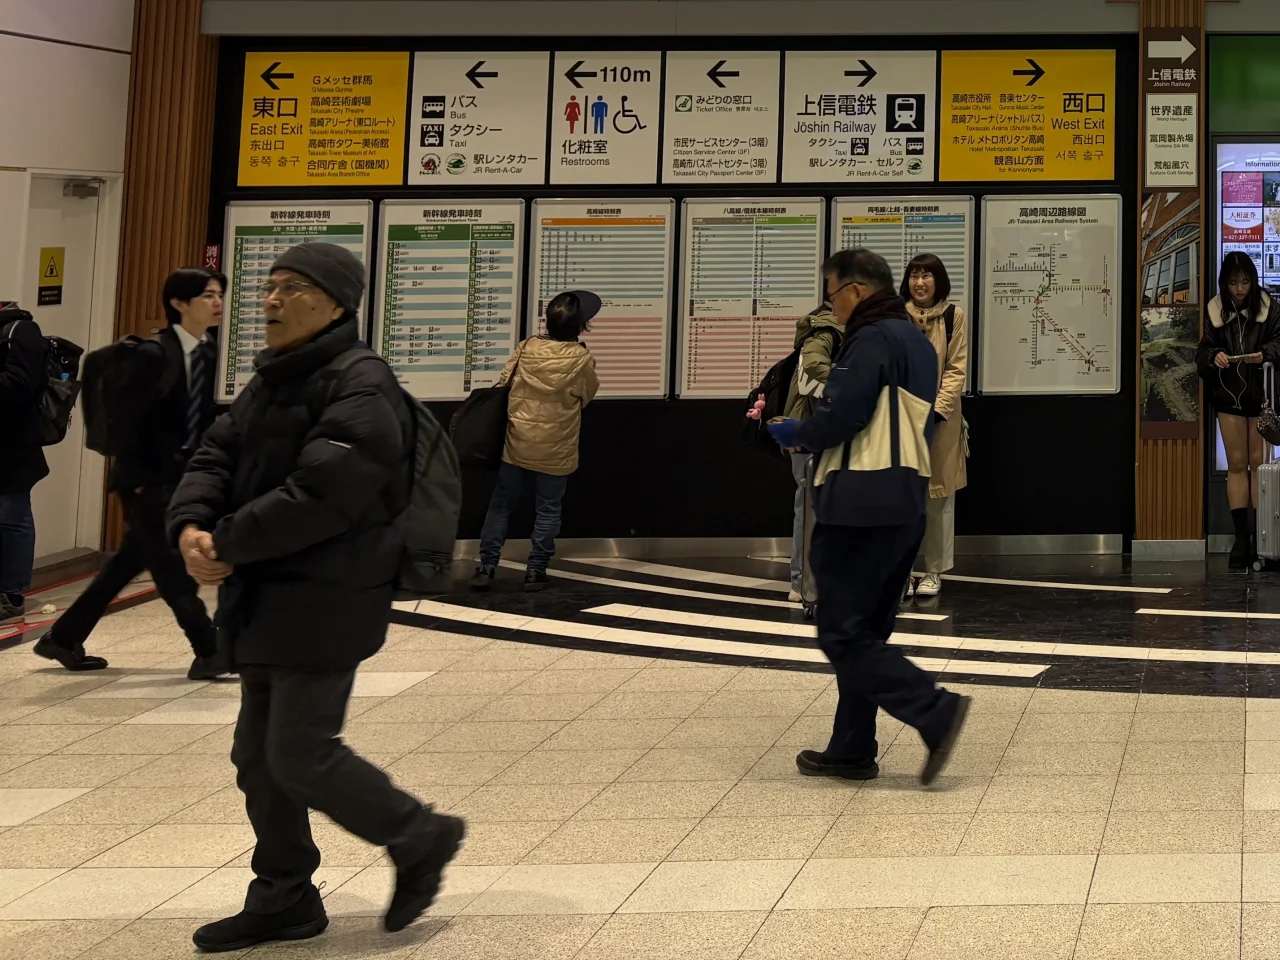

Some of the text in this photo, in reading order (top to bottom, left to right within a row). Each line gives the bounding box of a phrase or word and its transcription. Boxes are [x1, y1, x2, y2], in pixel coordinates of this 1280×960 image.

[600, 66, 651, 82] 110m
[1148, 69, 1196, 81] 上信電鉄
[312, 75, 372, 86] Gメッセ群馬
[310, 96, 372, 106] 高崎芸術劇場
[450, 95, 478, 108] バス
[696, 95, 752, 105] みどりの窓口
[952, 93, 1045, 103] 高崎市役所 音楽センター
[1062, 92, 1105, 113] 西口
[252, 96, 298, 119] 東口
[796, 94, 877, 116] 上信電鉄
[450, 111, 467, 119] Bus
[1150, 106, 1193, 116] 世界遺産
[833, 121, 876, 135] Railway
[1051, 118, 1105, 130] West Exit
[250, 123, 304, 136] East Exit
[449, 124, 502, 137] タクシー
[808, 138, 847, 147] タクシー
[883, 138, 902, 147] バス
[952, 135, 1045, 144] ホテル メトロポリタン高崎
[1072, 134, 1105, 145] 西出口
[1149, 134, 1194, 142] 富岡製糸場
[250, 140, 284, 151] 东出口
[308, 139, 389, 149] 高崎市タワー美術館
[449, 140, 467, 148] Taxi
[562, 139, 608, 154] 化粧室
[473, 154, 538, 164] 駅レンタカー
[561, 157, 610, 166] Restrooms
[994, 156, 1044, 166] 観音山方面
[270, 210, 331, 219] 新幹線発車時刻
[423, 209, 482, 218] 新幹線発車時刻
[1019, 207, 1086, 217] 高崎周辺路線図
[205, 246, 218, 270] 消火
